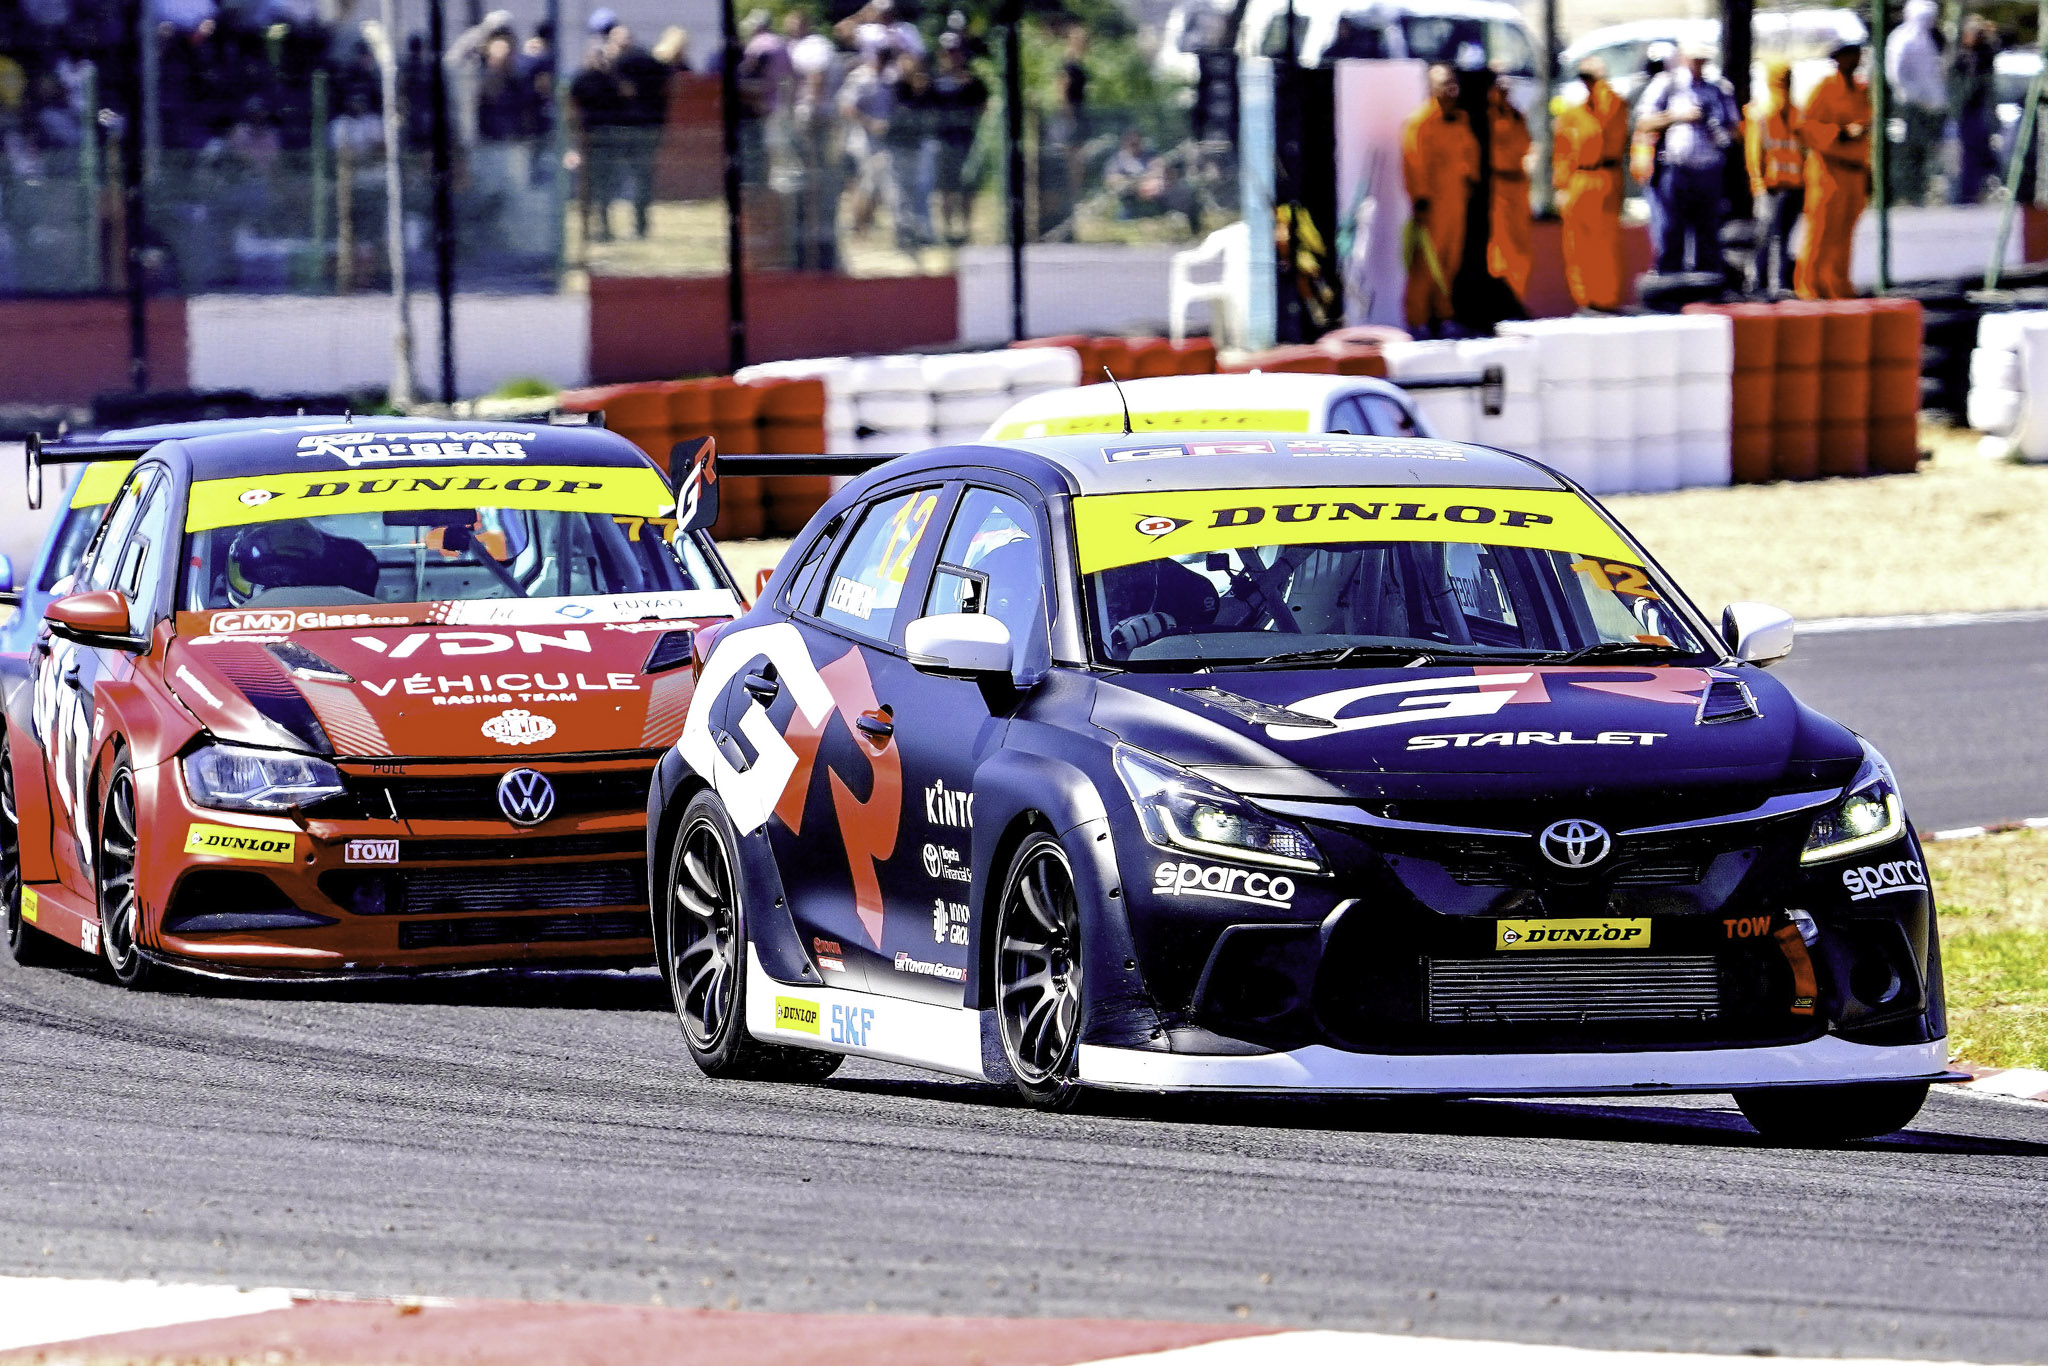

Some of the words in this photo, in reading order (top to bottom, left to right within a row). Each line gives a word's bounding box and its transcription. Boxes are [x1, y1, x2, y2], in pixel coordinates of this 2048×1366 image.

[1110, 442, 1270, 462] GR
[297, 477, 604, 499] DUNLOP
[1207, 502, 1554, 530] DUNLOP
[612, 516, 678, 543] 77
[876, 491, 939, 584] 12
[1570, 558, 1661, 601] 12
[351, 629, 593, 658] VDN
[360, 672, 641, 697] VÉHICULE
[432, 693, 513, 706] RACING
[518, 692, 578, 703] TEAM
[1265, 665, 1713, 741] GR
[1406, 731, 1669, 751] STARLET
[677, 621, 903, 950] GR
[205, 834, 291, 854] DUNLOP
[349, 843, 395, 860] TOW
[1154, 862, 1296, 903] sparco
[1842, 860, 1927, 900] sparc
[1524, 926, 1643, 944] DUNLOP
[1723, 915, 1771, 939] TOW
[783, 1006, 818, 1024] DUNLOP
[830, 1004, 875, 1046] SKF
